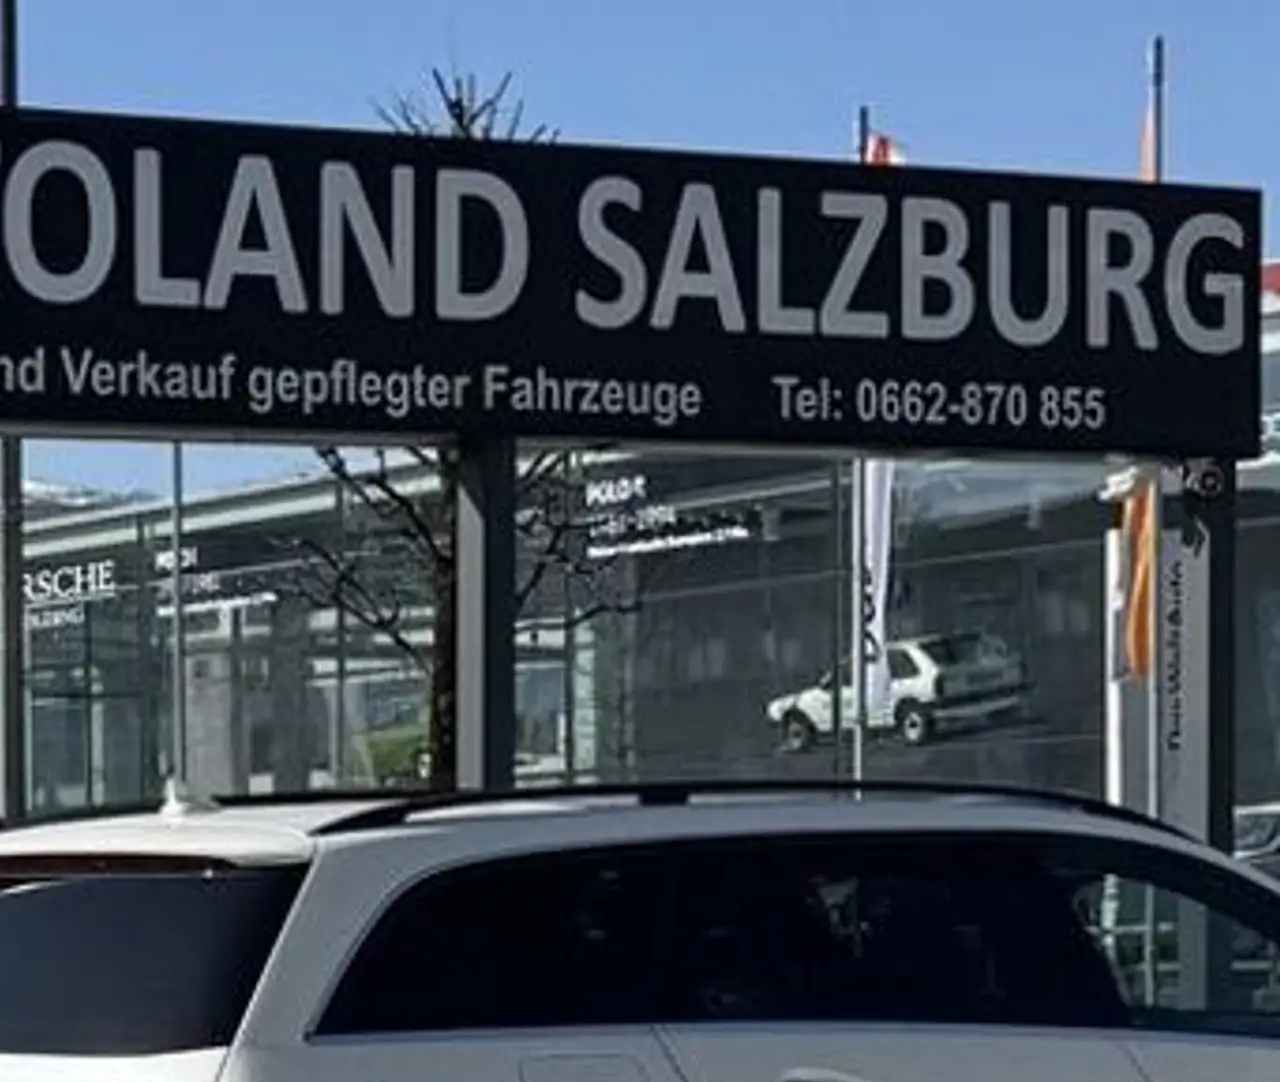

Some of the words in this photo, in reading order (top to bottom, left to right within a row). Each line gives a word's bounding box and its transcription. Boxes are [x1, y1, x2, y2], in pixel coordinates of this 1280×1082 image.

[574, 175, 1246, 355] SALZBURG
[60, 347, 238, 400] Verkauf
[247, 359, 472, 417] gepflegter
[482, 365, 703, 427] Fahrzeuge
[770, 376, 843, 422] Tel:
[856, 378, 1028, 427] 0662-870
[1038, 386, 1107, 430] 855
